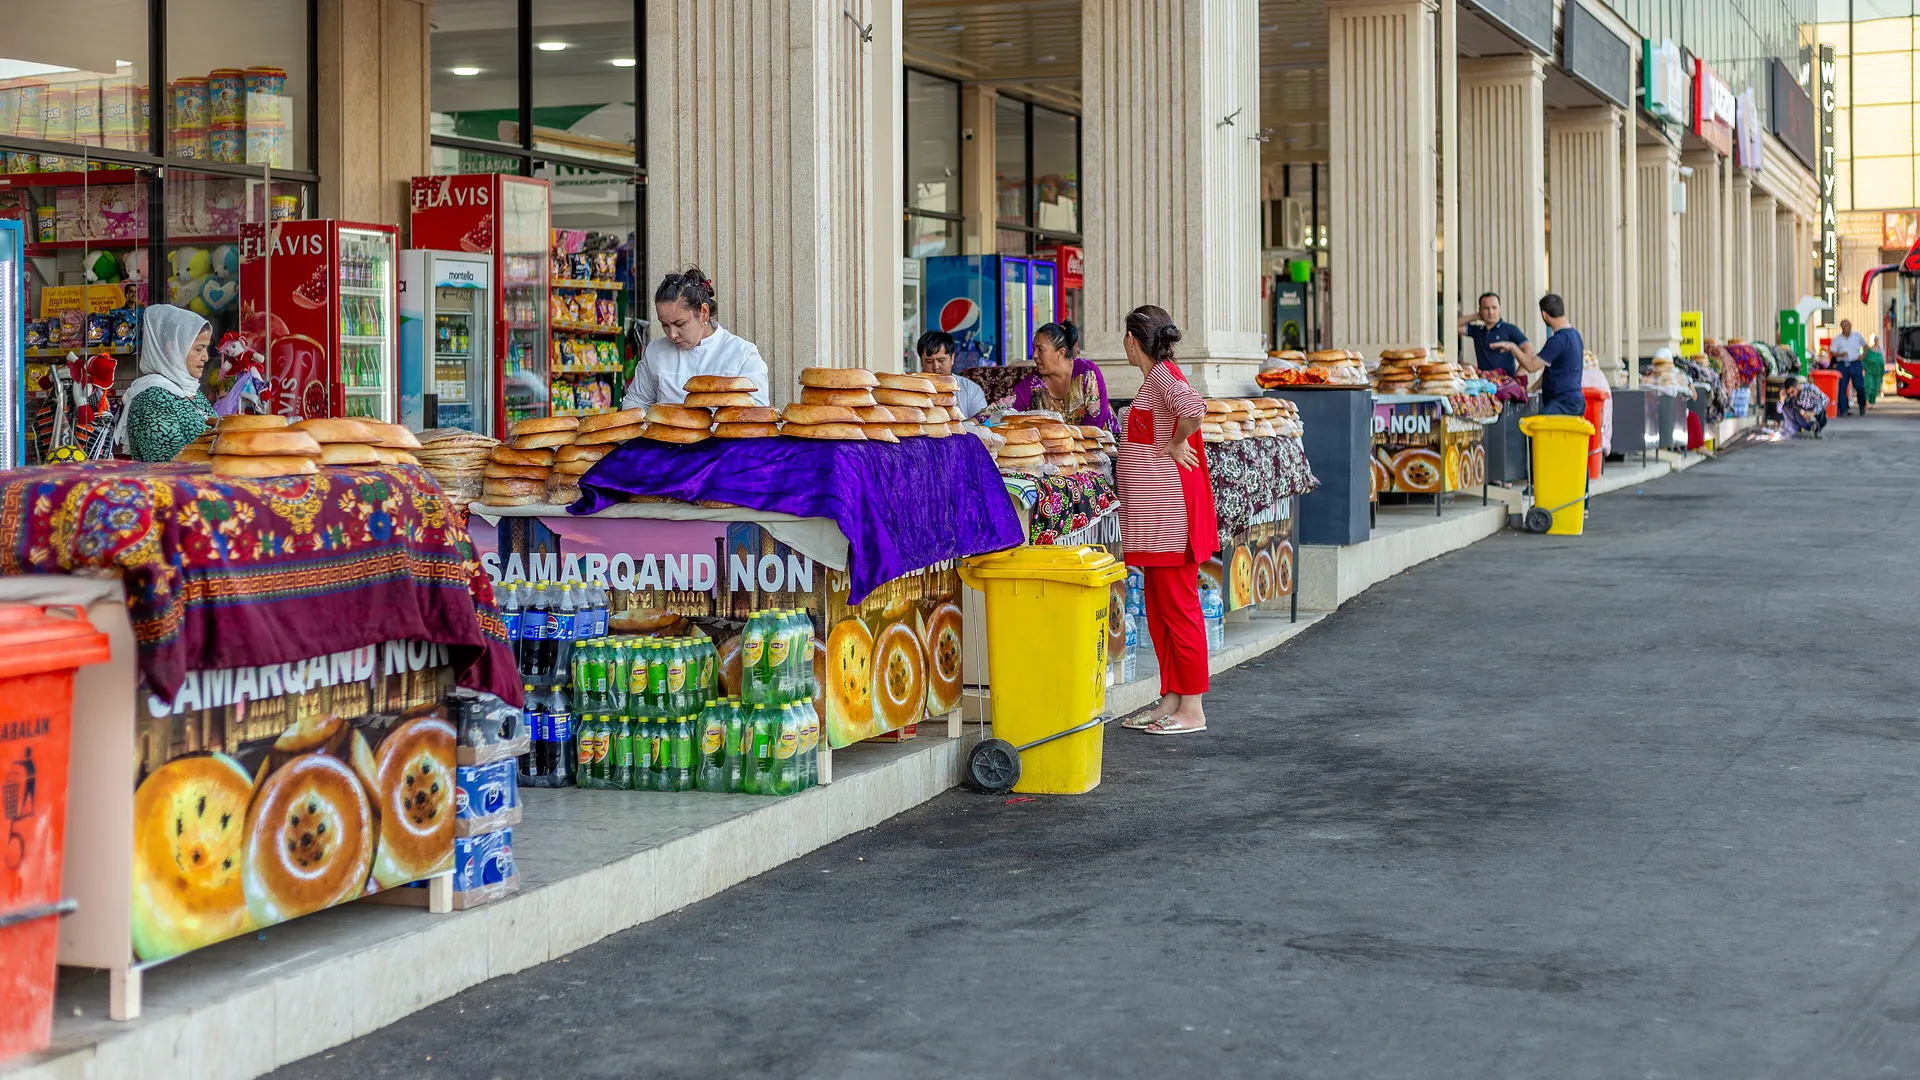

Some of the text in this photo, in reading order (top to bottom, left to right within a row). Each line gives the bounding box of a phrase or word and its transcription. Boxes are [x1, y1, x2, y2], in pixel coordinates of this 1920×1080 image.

[415, 186, 489, 208] FLAVIS
[243, 233, 323, 258] FLAVIS
[448, 270, 474, 281] montella
[1391, 415, 1430, 434] NON
[482, 552, 716, 594] SAMARQAND
[730, 553, 813, 593] NON
[0, 717, 50, 743] ABALAN
